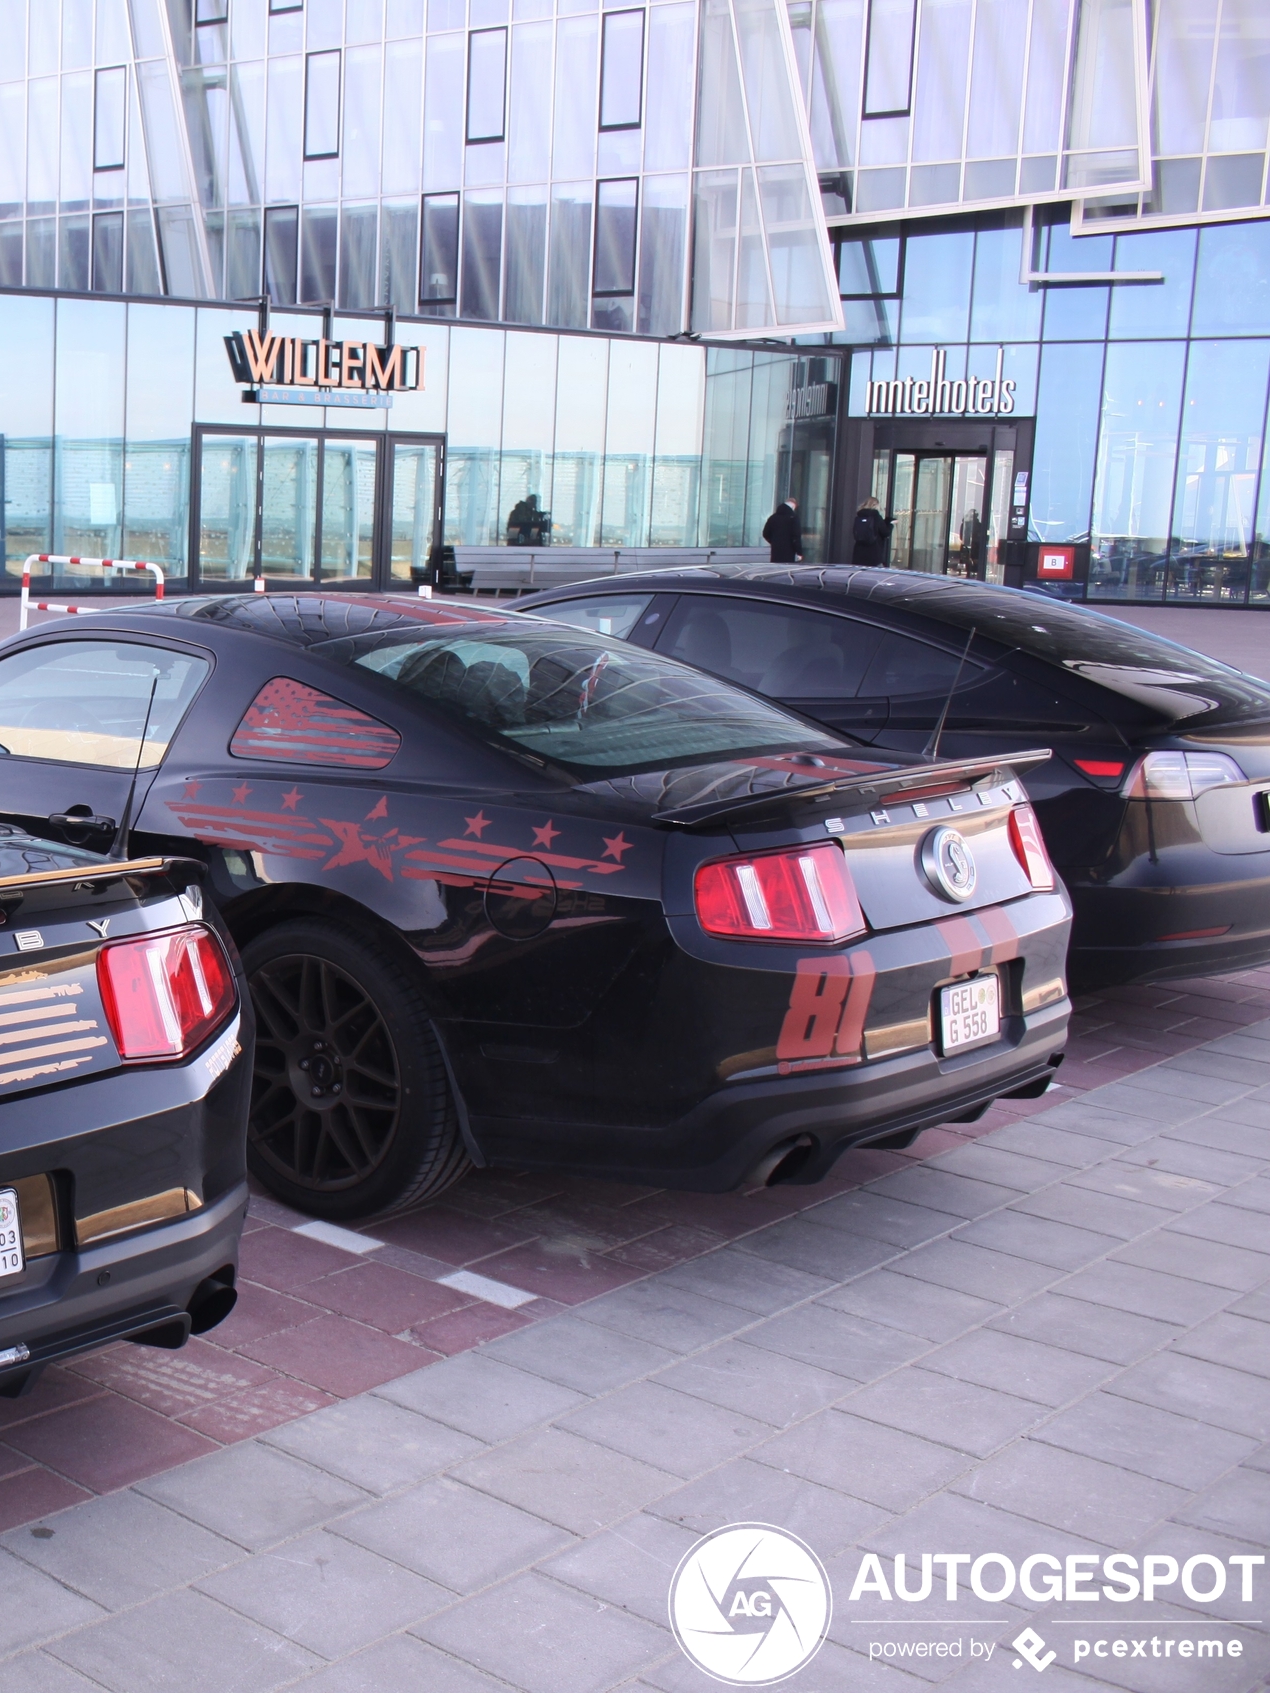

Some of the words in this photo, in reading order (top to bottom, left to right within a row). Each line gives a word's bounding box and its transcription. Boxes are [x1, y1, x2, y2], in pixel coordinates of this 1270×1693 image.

[241, 329, 401, 390] WILLEM
[416, 346, 427, 391] I
[865, 348, 1015, 413] inntelhotels
[262, 390, 289, 401] BAR
[298, 393, 306, 402] &
[315, 393, 392, 406] BRASSERIE
[1051, 558, 1057, 566] B
[824, 787, 1015, 833] SHELBY
[776, 949, 876, 1059] 81
[951, 987, 978, 1016] GEL
[950, 1019, 959, 1044] G
[963, 1010, 988, 1040] 558
[2, 1253, 19, 1269] 10
